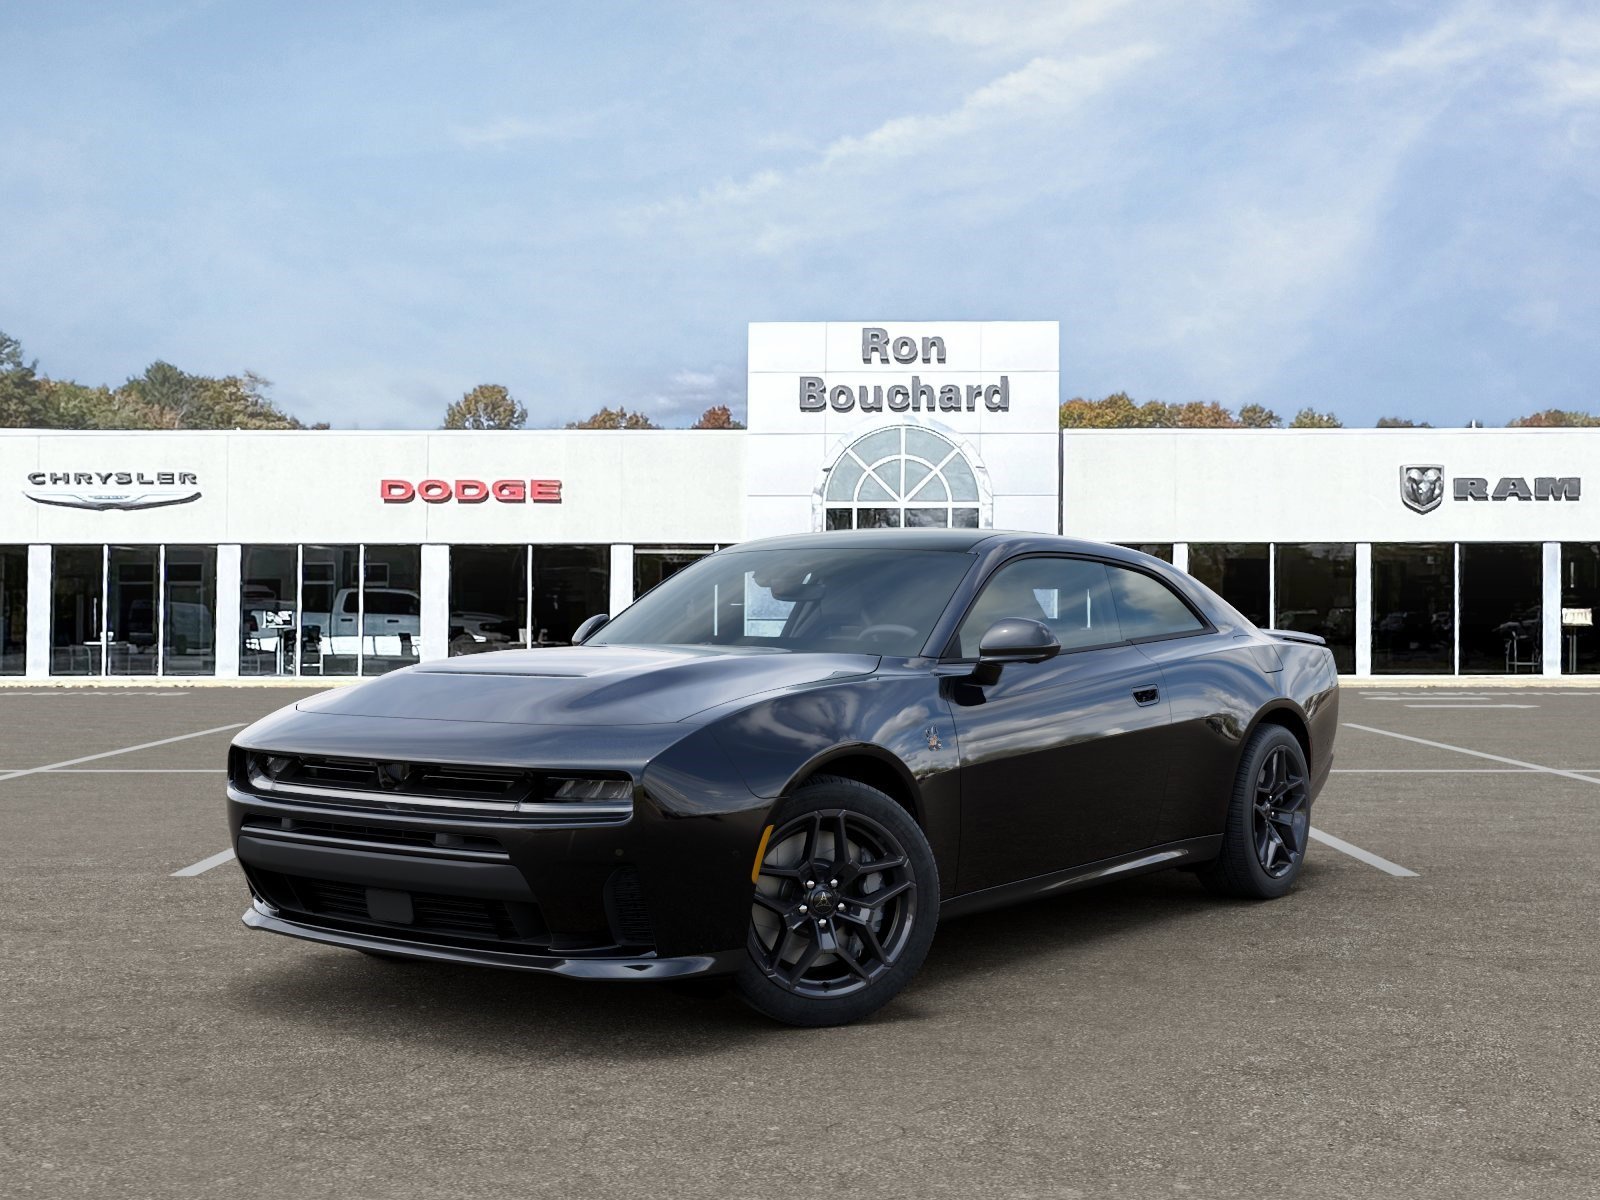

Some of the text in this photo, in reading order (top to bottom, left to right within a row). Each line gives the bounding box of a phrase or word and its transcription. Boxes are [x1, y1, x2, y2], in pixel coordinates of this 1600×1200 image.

[861, 327, 947, 364] Ron
[799, 375, 1010, 413] Bouchard
[27, 472, 198, 486] CHRYSLER
[380, 479, 563, 504] DODGE
[1453, 477, 1582, 501] RAM
